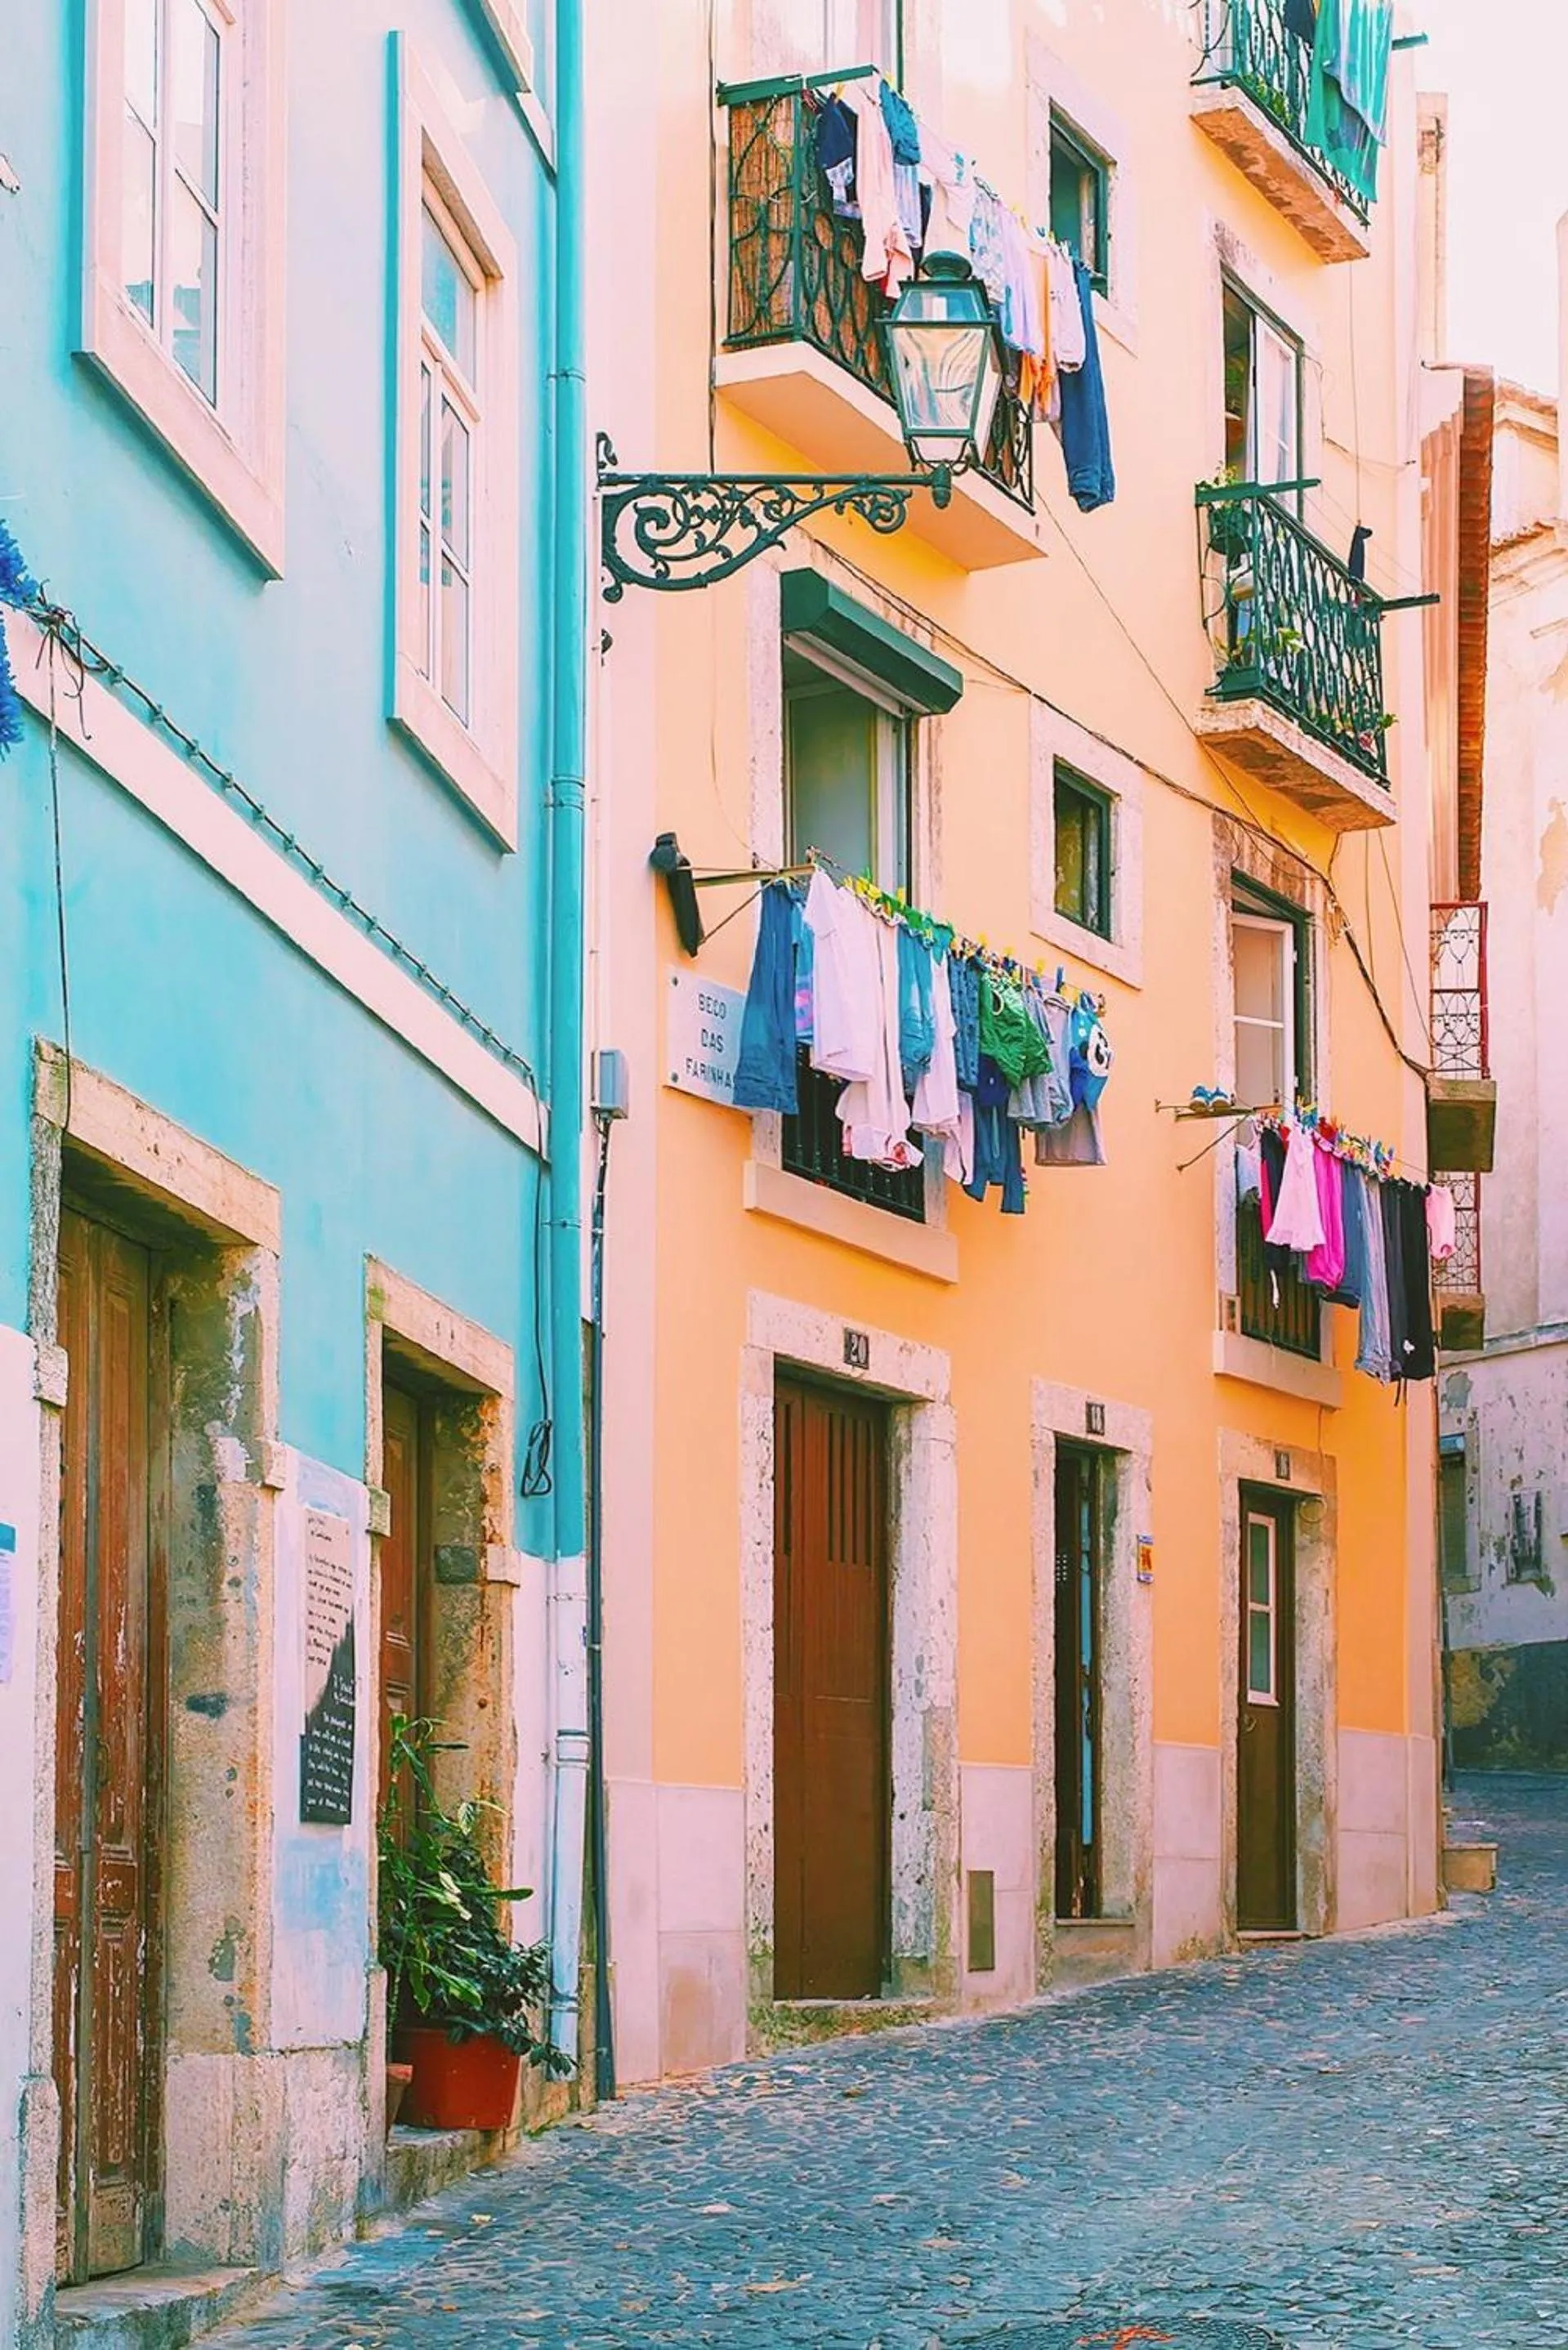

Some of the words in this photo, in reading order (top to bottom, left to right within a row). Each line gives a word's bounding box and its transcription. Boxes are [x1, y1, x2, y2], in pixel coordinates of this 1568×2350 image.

[701, 1029, 724, 1052] DAS
[686, 1057, 735, 1088] FARINHA
[850, 1334, 867, 1364] 20
